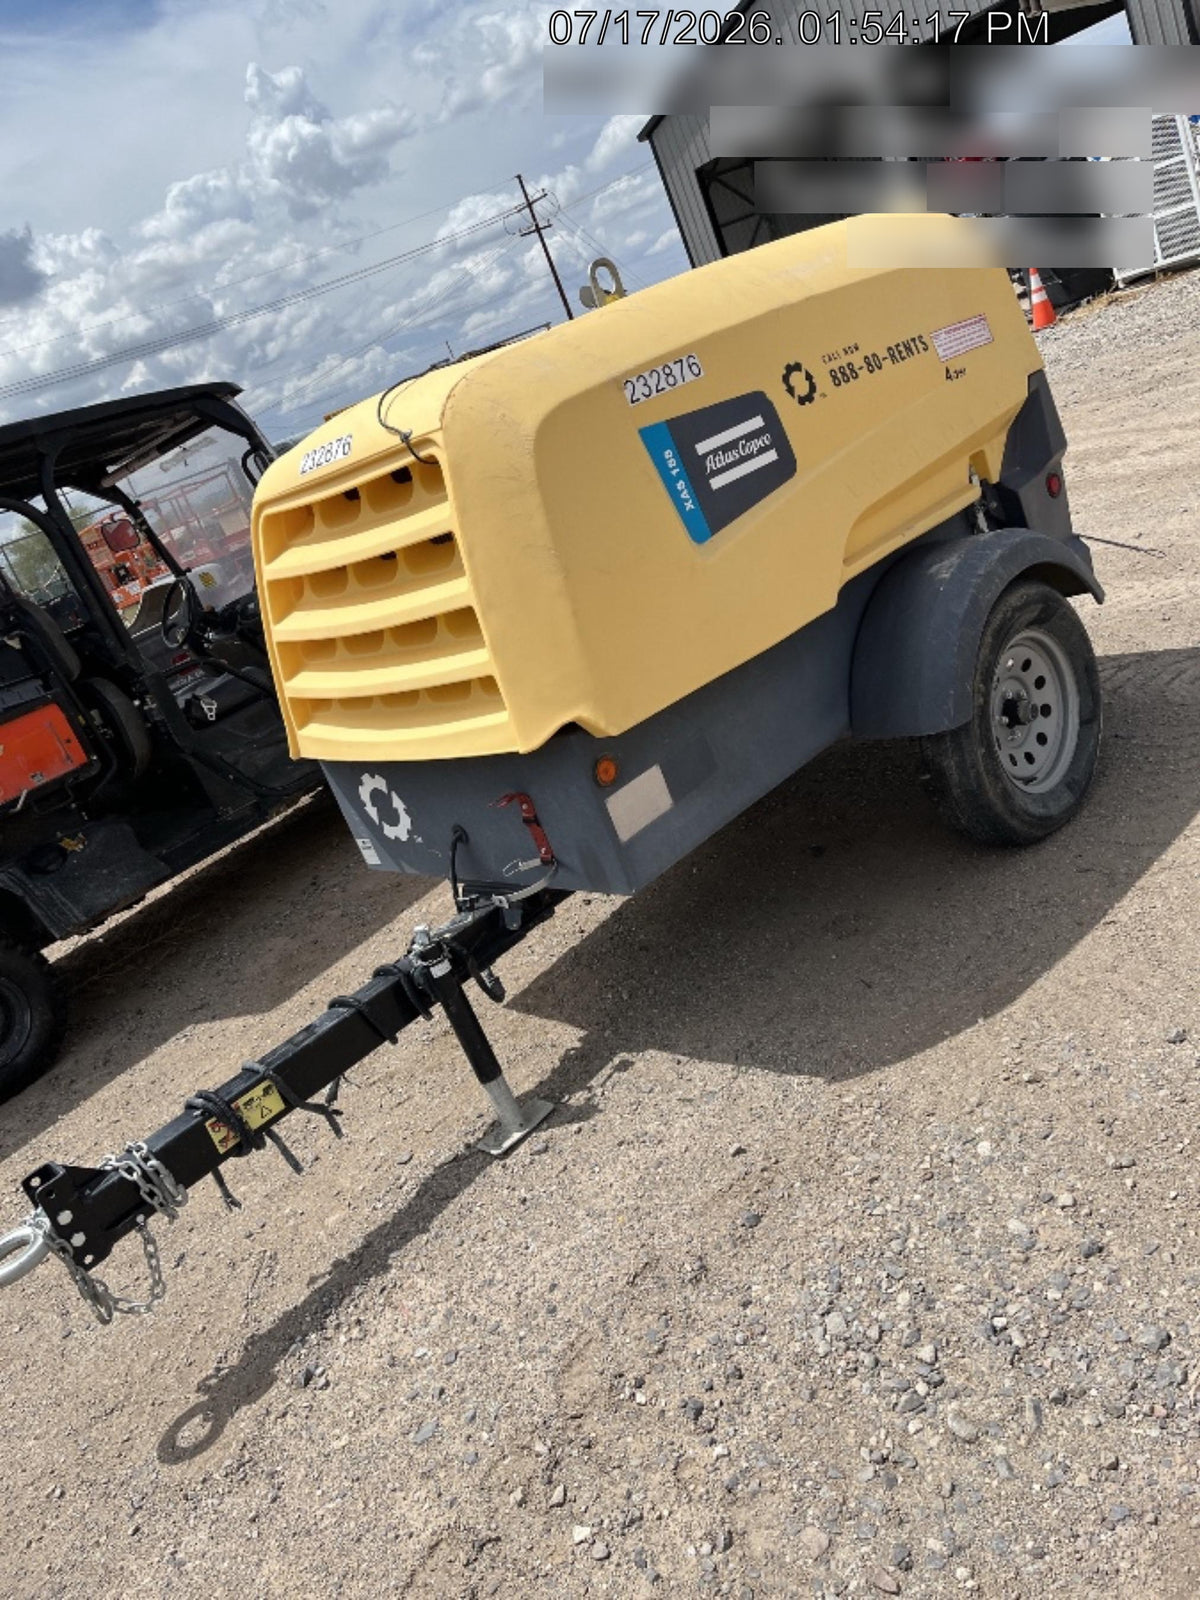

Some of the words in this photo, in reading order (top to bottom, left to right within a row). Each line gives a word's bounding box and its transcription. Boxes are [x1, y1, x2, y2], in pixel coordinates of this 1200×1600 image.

[829, 334, 929, 387] 888-80-RENTS
[842, 343, 859, 356] NOW
[623, 355, 701, 404] 232876
[300, 434, 352, 475] 232876
[705, 447, 740, 475] Atlas
[739, 433, 772, 457] Copco
[675, 479, 695, 512] XAS
